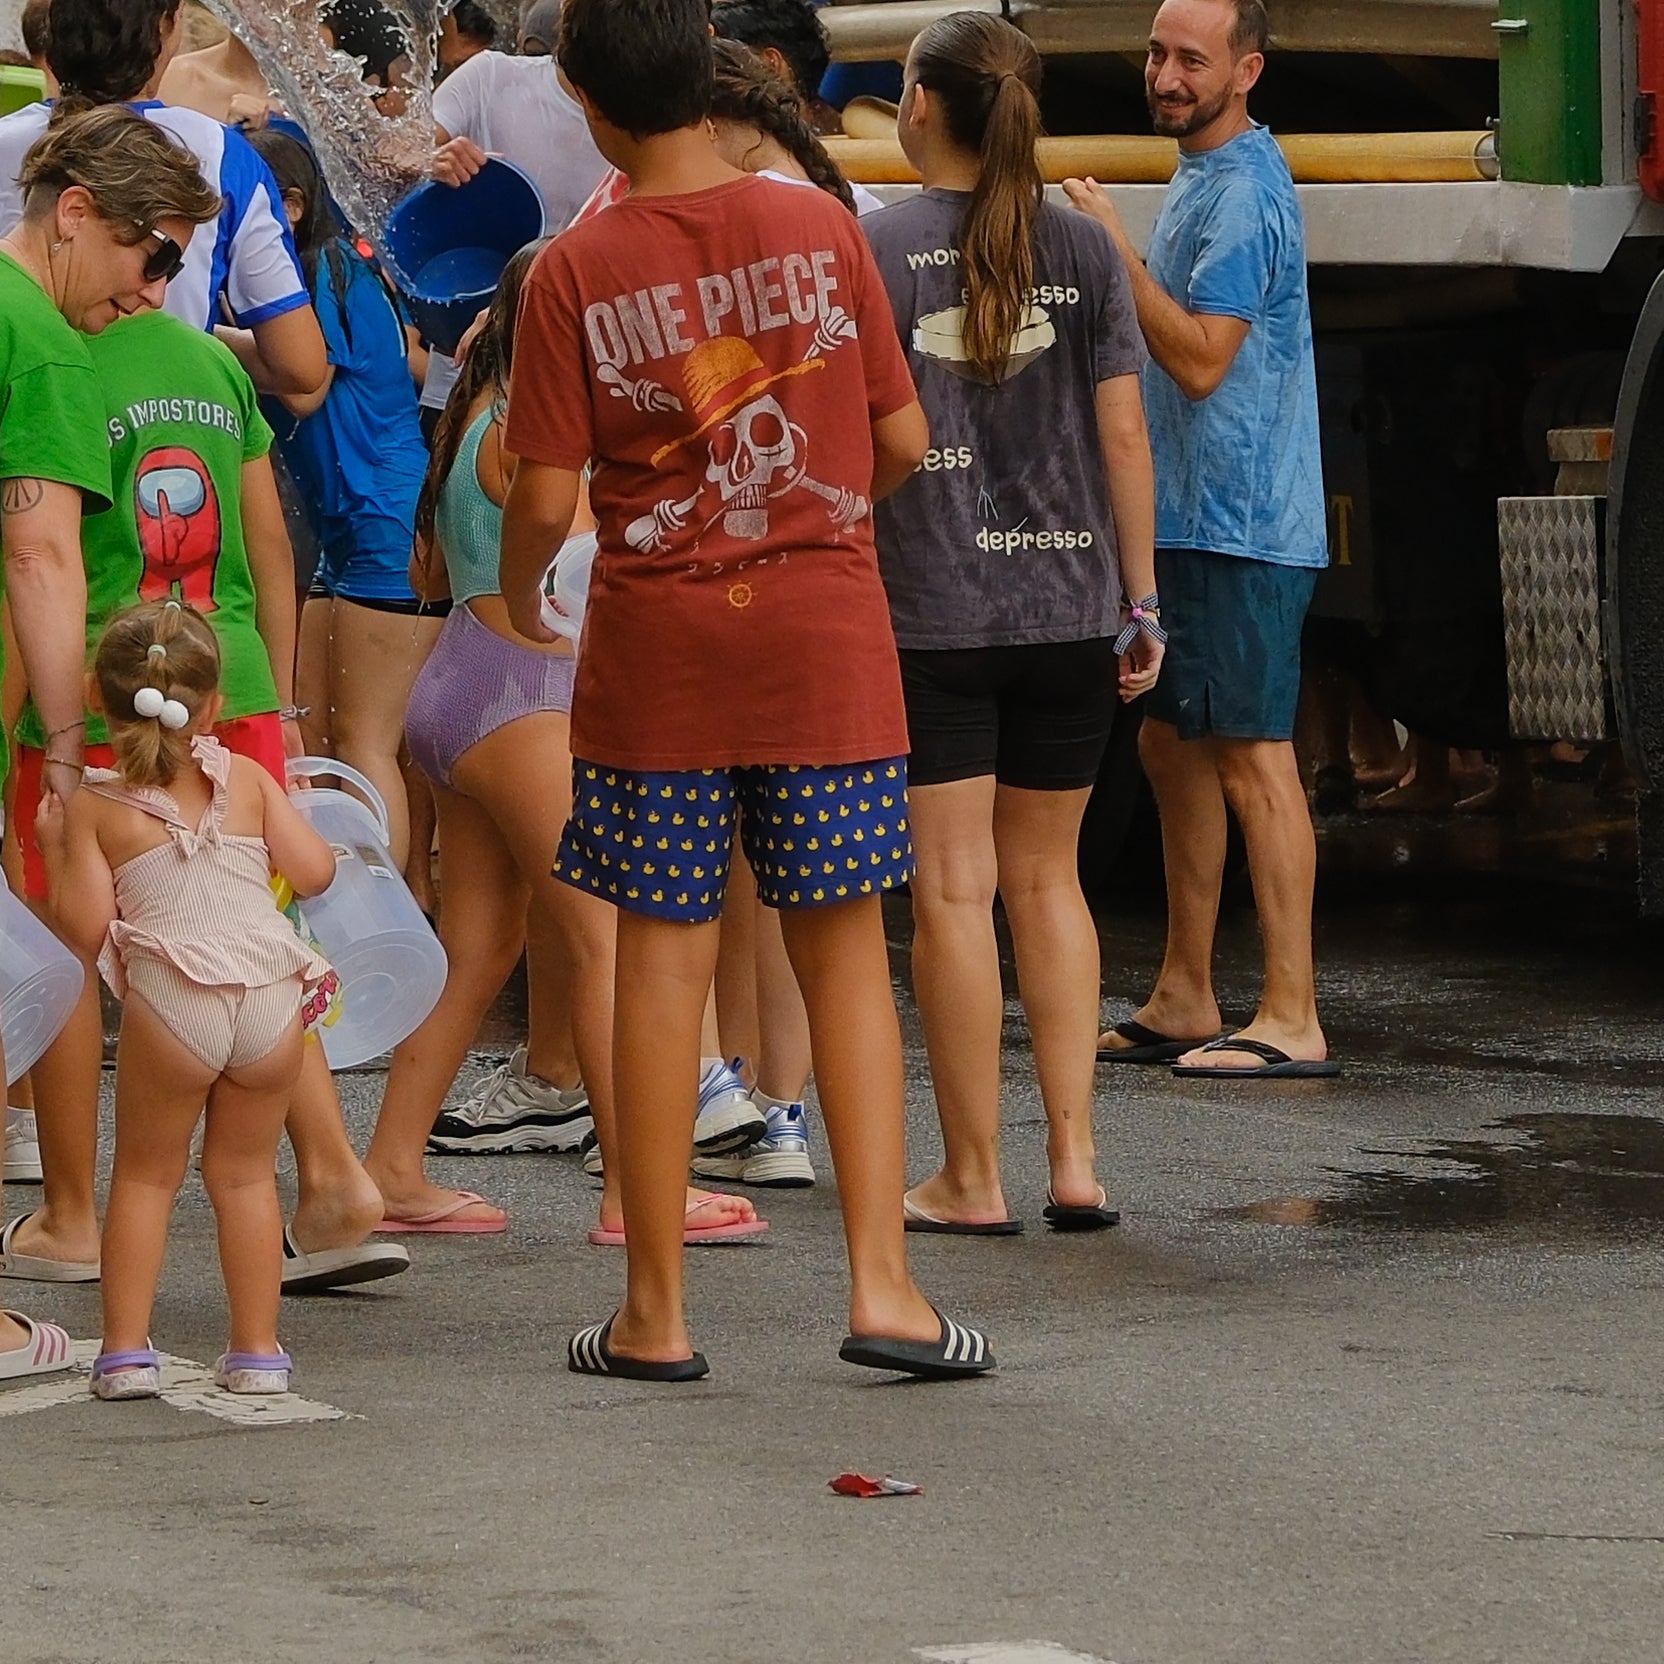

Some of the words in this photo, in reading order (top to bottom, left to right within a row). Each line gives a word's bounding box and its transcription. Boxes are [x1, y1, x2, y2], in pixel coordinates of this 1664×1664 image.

[907, 248, 961, 270] mor
[585, 283, 695, 370] ONE
[696, 250, 838, 337] PIECE
[126, 398, 241, 440] IMPOSTORES
[914, 446, 973, 472] ess
[976, 527, 1093, 556] depresso
